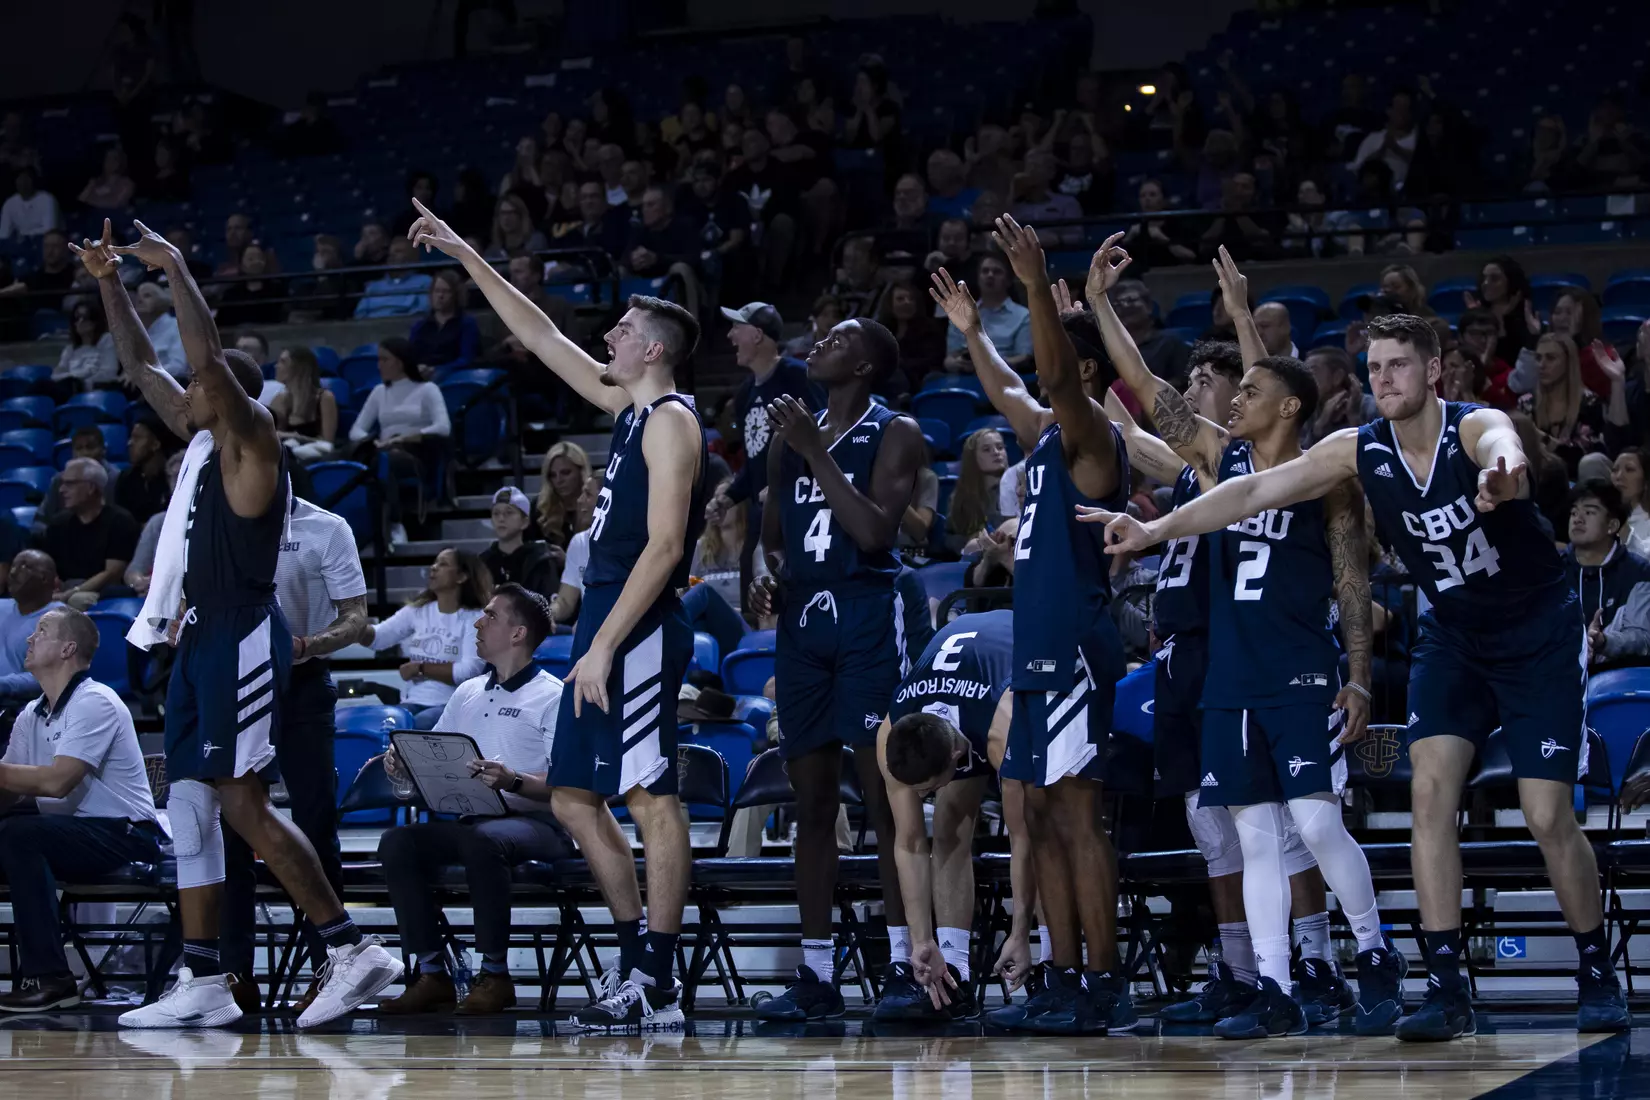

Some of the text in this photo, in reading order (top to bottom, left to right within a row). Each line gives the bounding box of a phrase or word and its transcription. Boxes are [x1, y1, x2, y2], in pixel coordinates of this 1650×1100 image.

[852, 435, 871, 444] WAC
[804, 508, 833, 563] 4
[1227, 508, 1294, 541] BU
[1402, 495, 1476, 542] CBU
[1156, 534, 1200, 592] 23
[1233, 540, 1271, 601] 2
[1422, 526, 1501, 593] 34
[932, 631, 978, 672] 3
[498, 707, 522, 718] CBU
